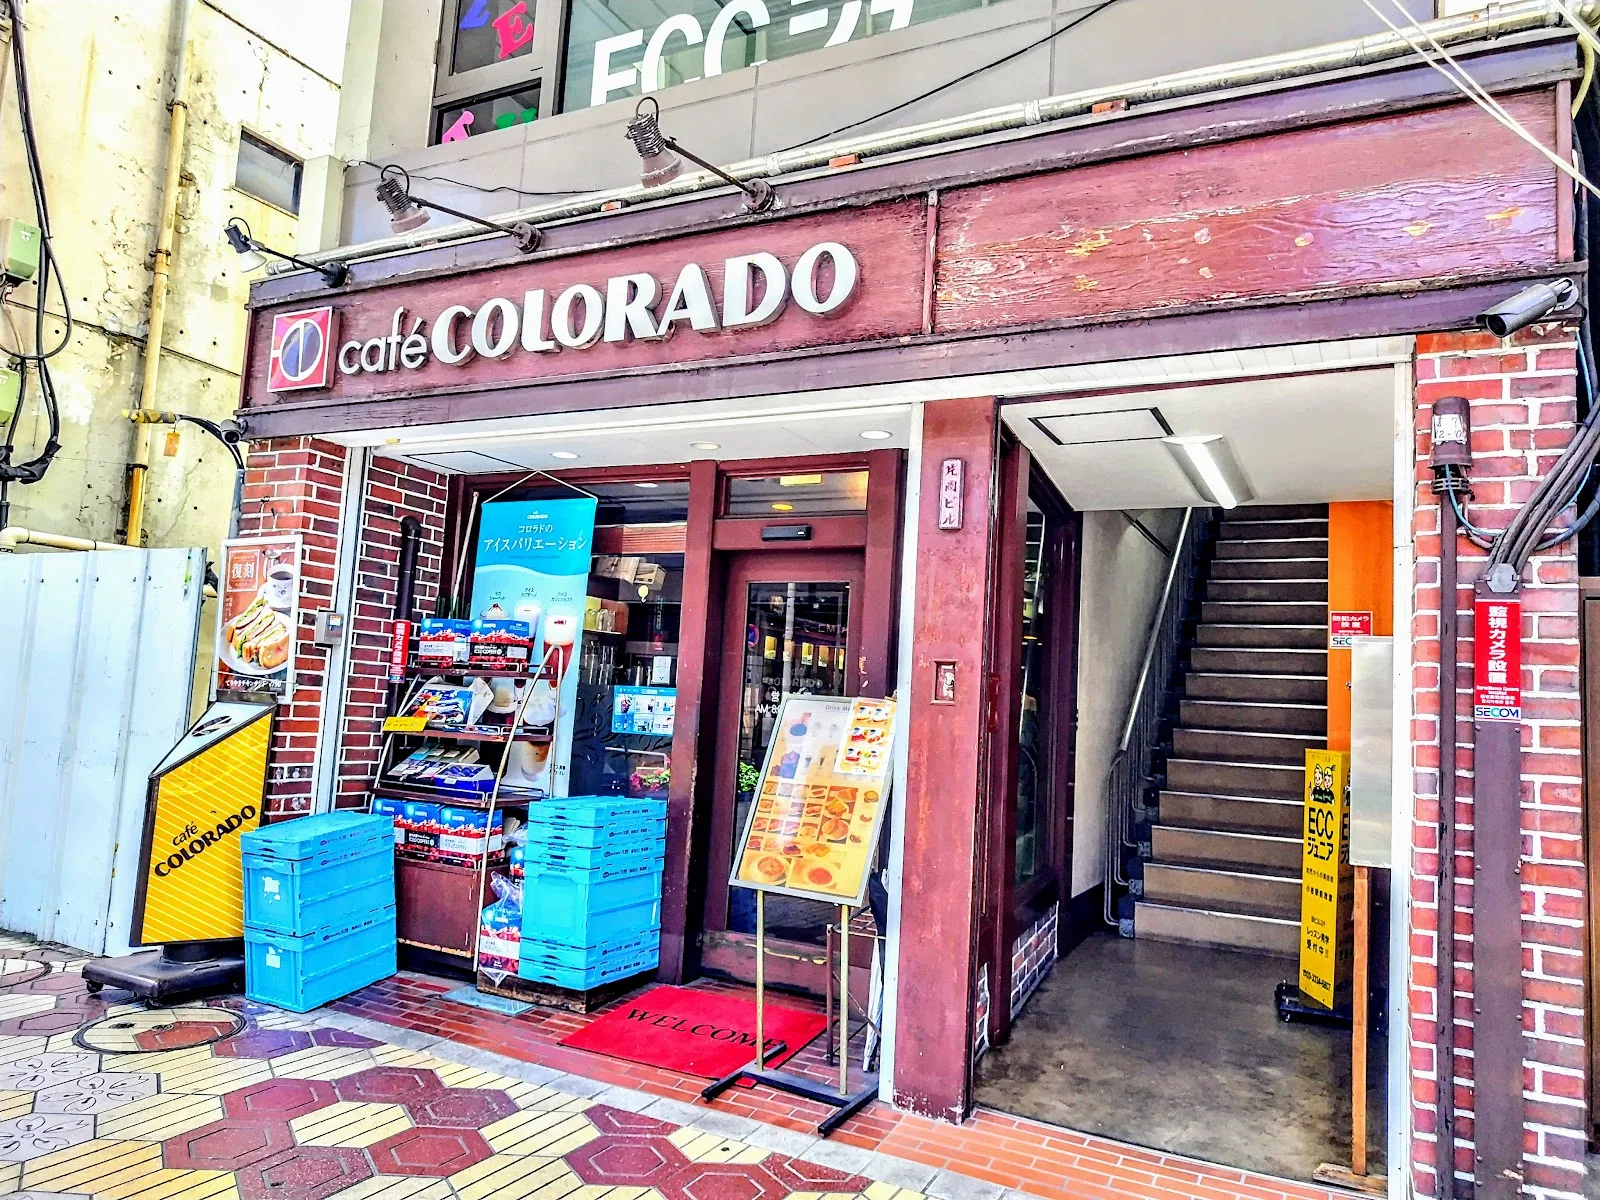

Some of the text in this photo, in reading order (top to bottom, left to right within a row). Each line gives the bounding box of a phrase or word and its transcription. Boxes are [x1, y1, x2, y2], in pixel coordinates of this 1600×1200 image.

[338, 241, 860, 375] café COLORADO
[518, 524, 553, 534] コロラドの
[484, 536, 588, 552] アイスバリエーション
[232, 562, 255, 578] 復刻
[1332, 637, 1352, 645] SEC
[1488, 606, 1508, 684] 監視カメラ設置
[1476, 707, 1519, 718] SECOM
[172, 821, 198, 846] café
[1308, 807, 1334, 840] ECC
[154, 805, 256, 877] COLORADO
[1307, 836, 1334, 861] ジュニア
[626, 1008, 786, 1051] WELCOME
